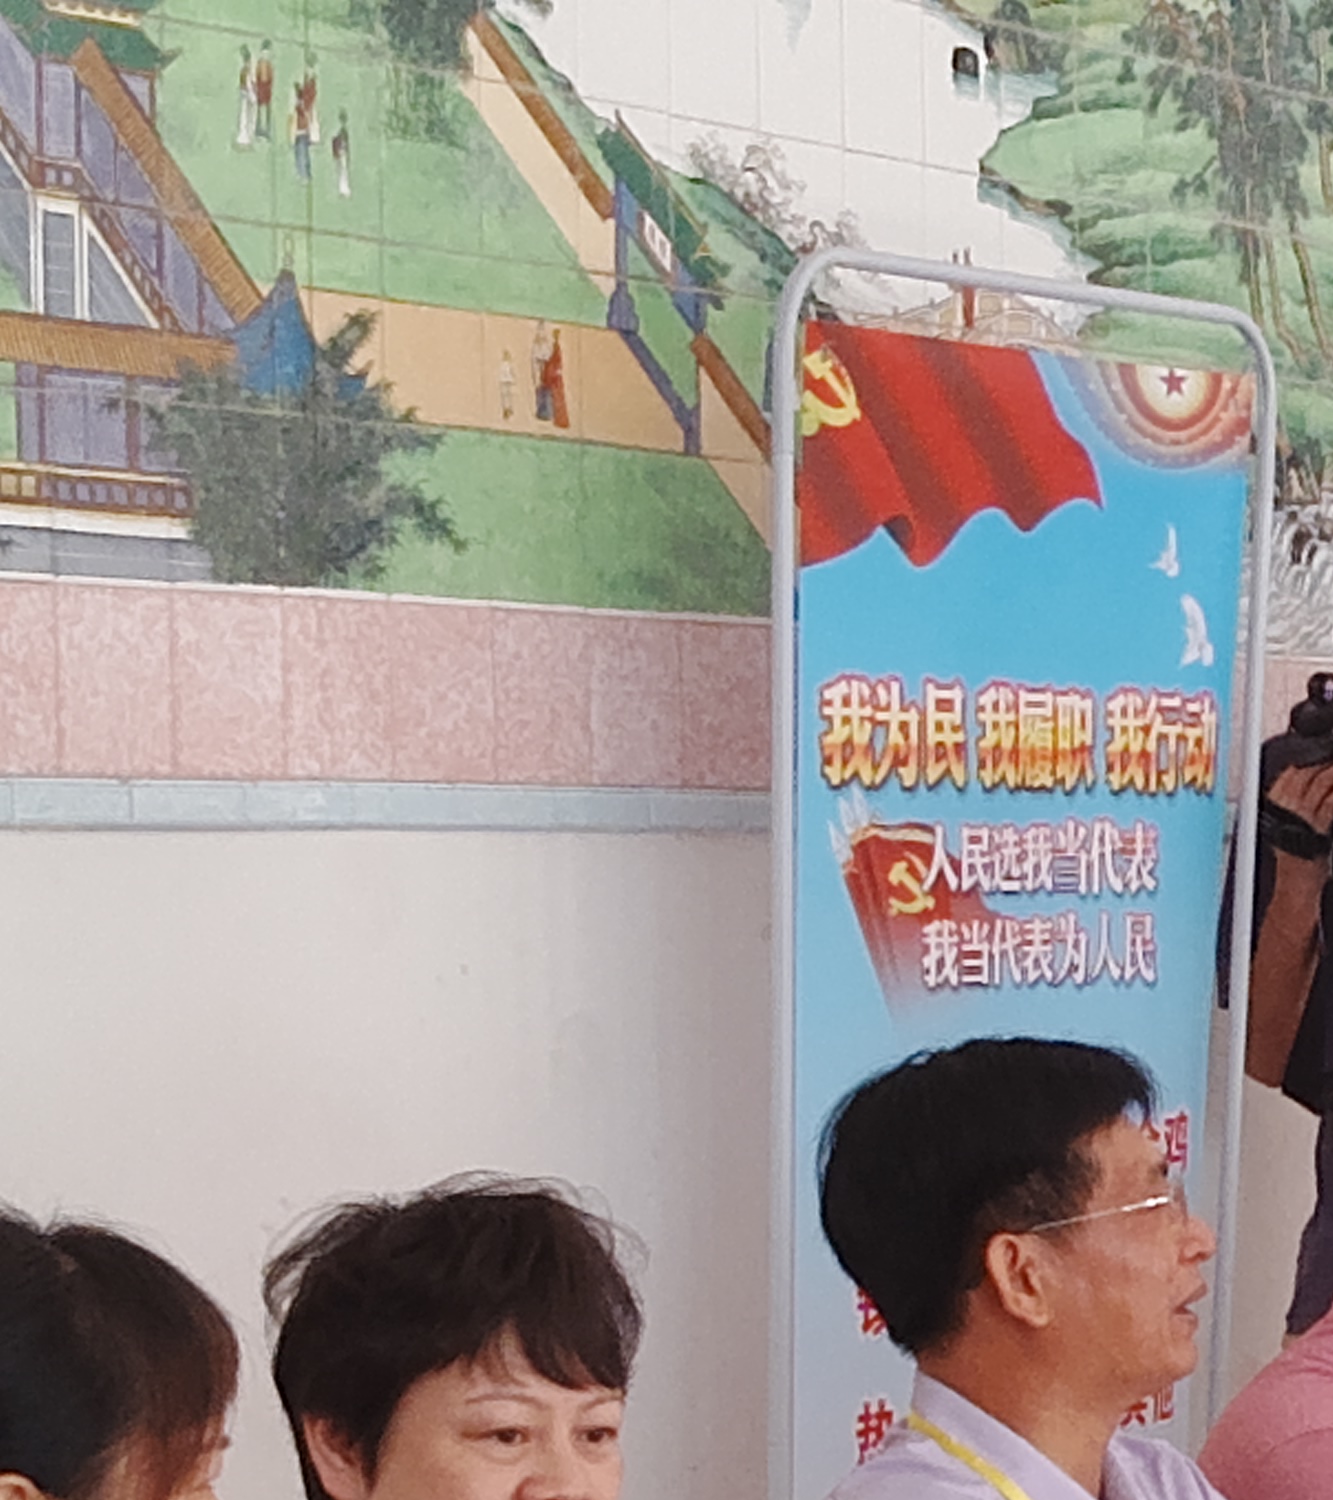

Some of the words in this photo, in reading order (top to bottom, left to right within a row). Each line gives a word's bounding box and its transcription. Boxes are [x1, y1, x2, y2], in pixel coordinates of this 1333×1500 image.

[818, 678, 968, 788] 我为民
[976, 685, 1095, 792] 我履职
[1105, 692, 1218, 794] 我行动
[922, 818, 1159, 893] 人民选我当代表
[921, 913, 1158, 987] 我当代表为人民
